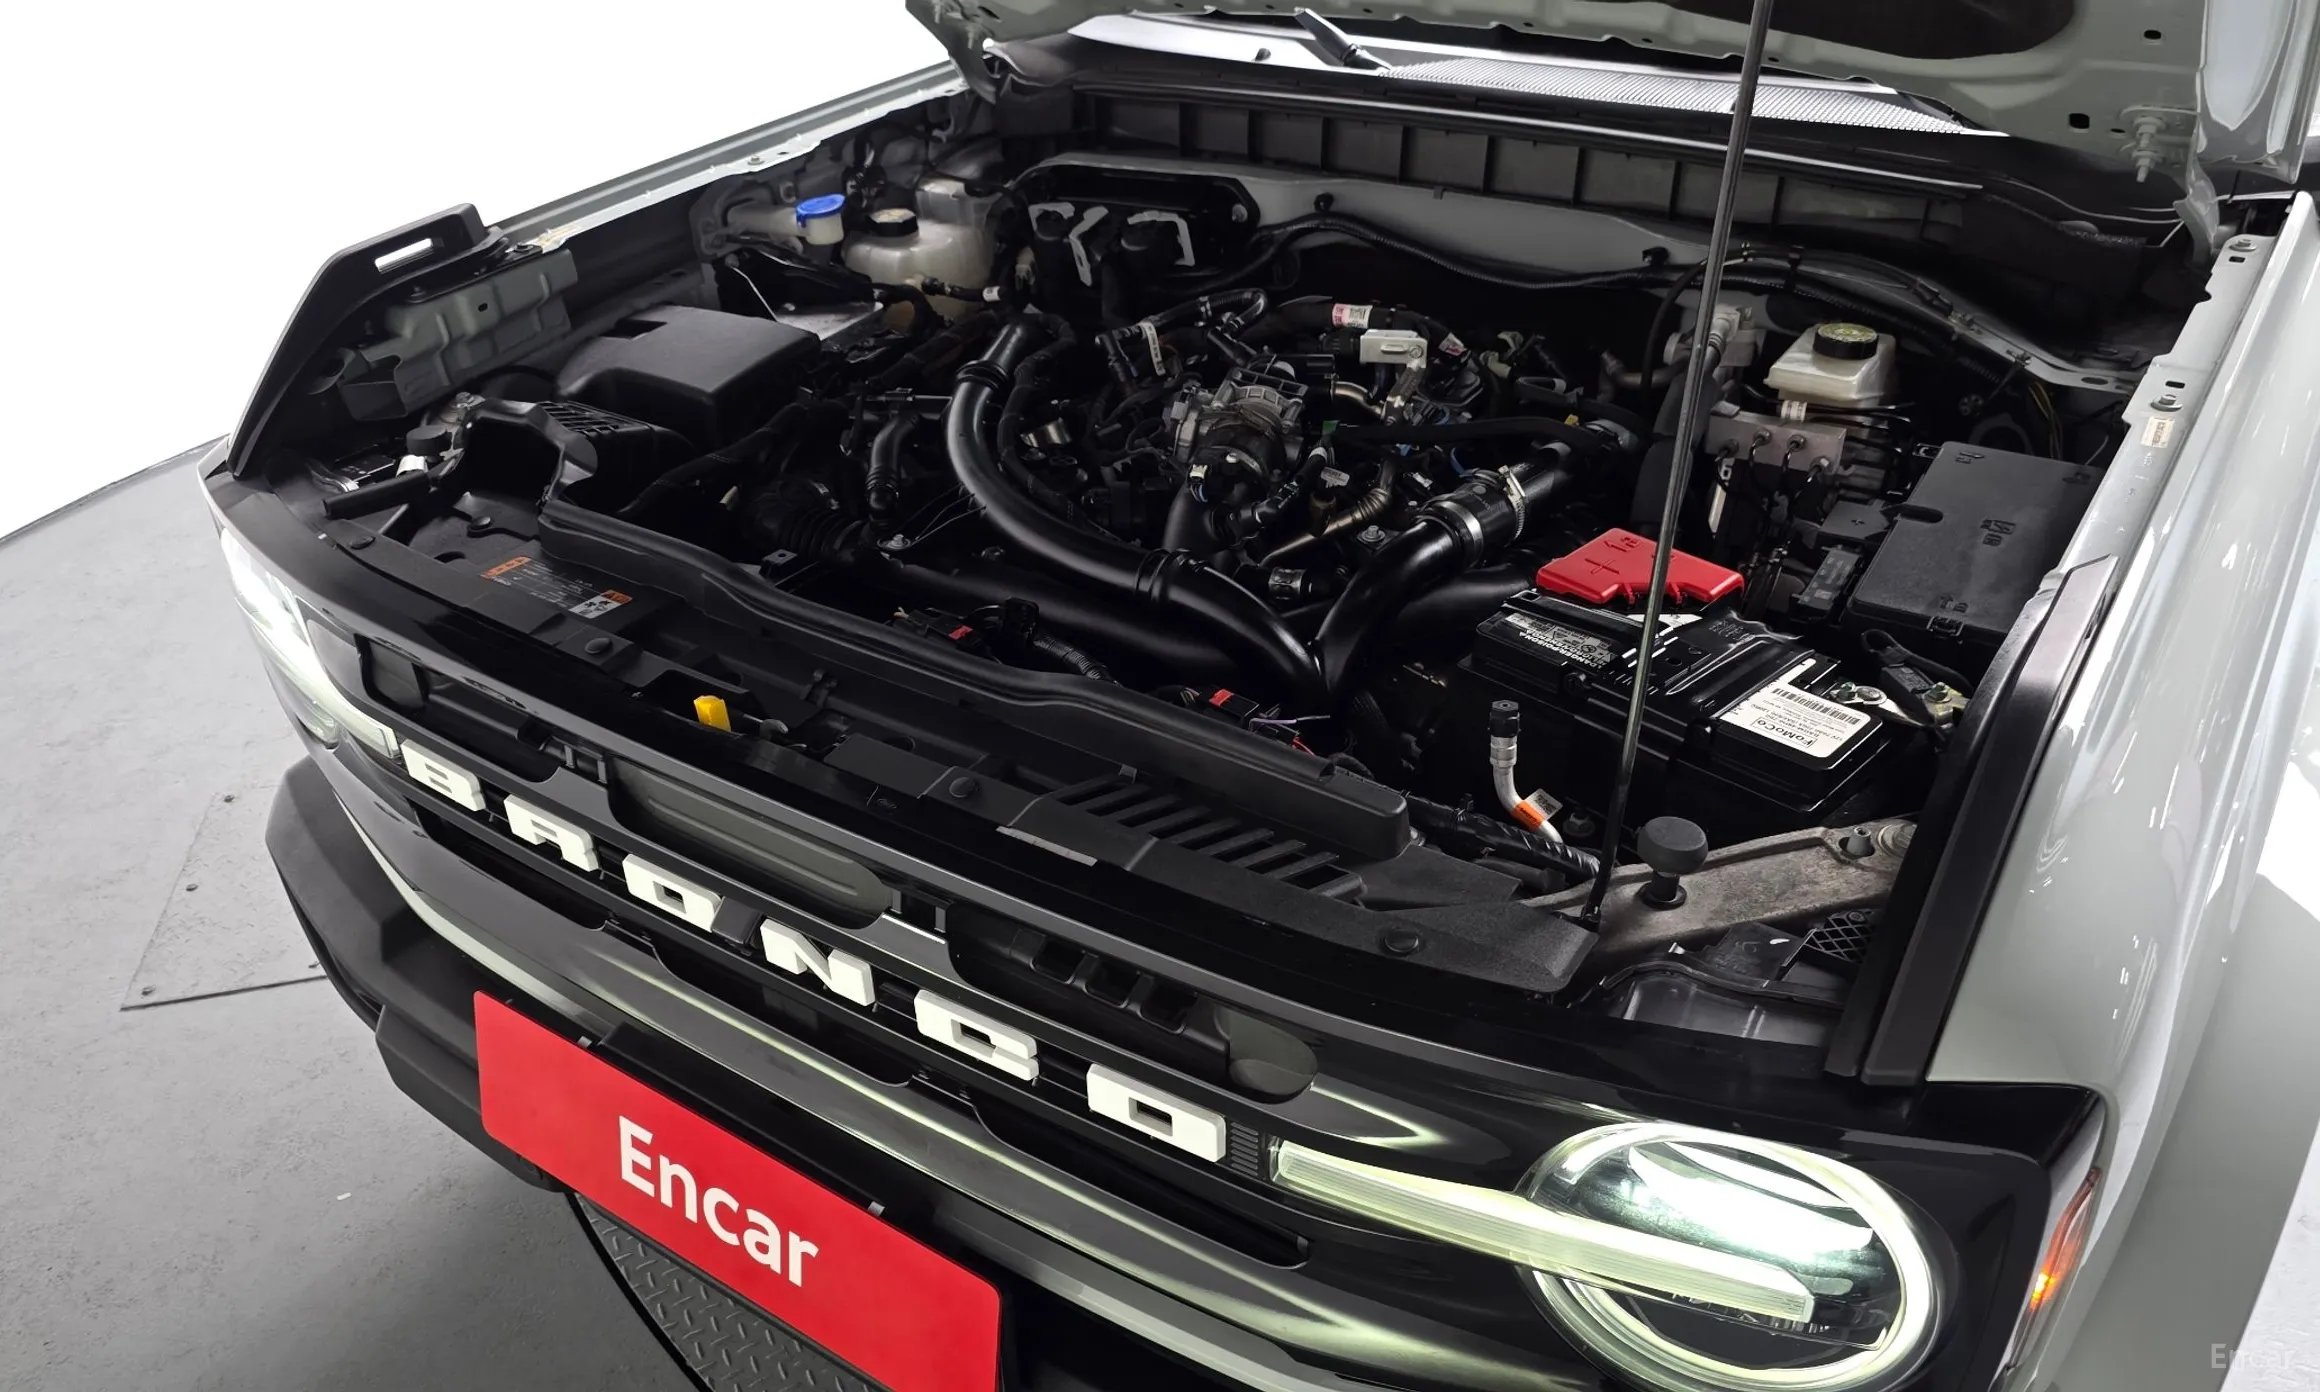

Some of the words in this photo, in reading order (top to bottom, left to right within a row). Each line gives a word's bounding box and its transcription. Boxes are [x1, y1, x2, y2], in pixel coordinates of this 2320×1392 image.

[1757, 719, 1813, 746] FoMoCo
[401, 739, 1227, 1162] BRONCO
[619, 1115, 819, 1287] Encar
